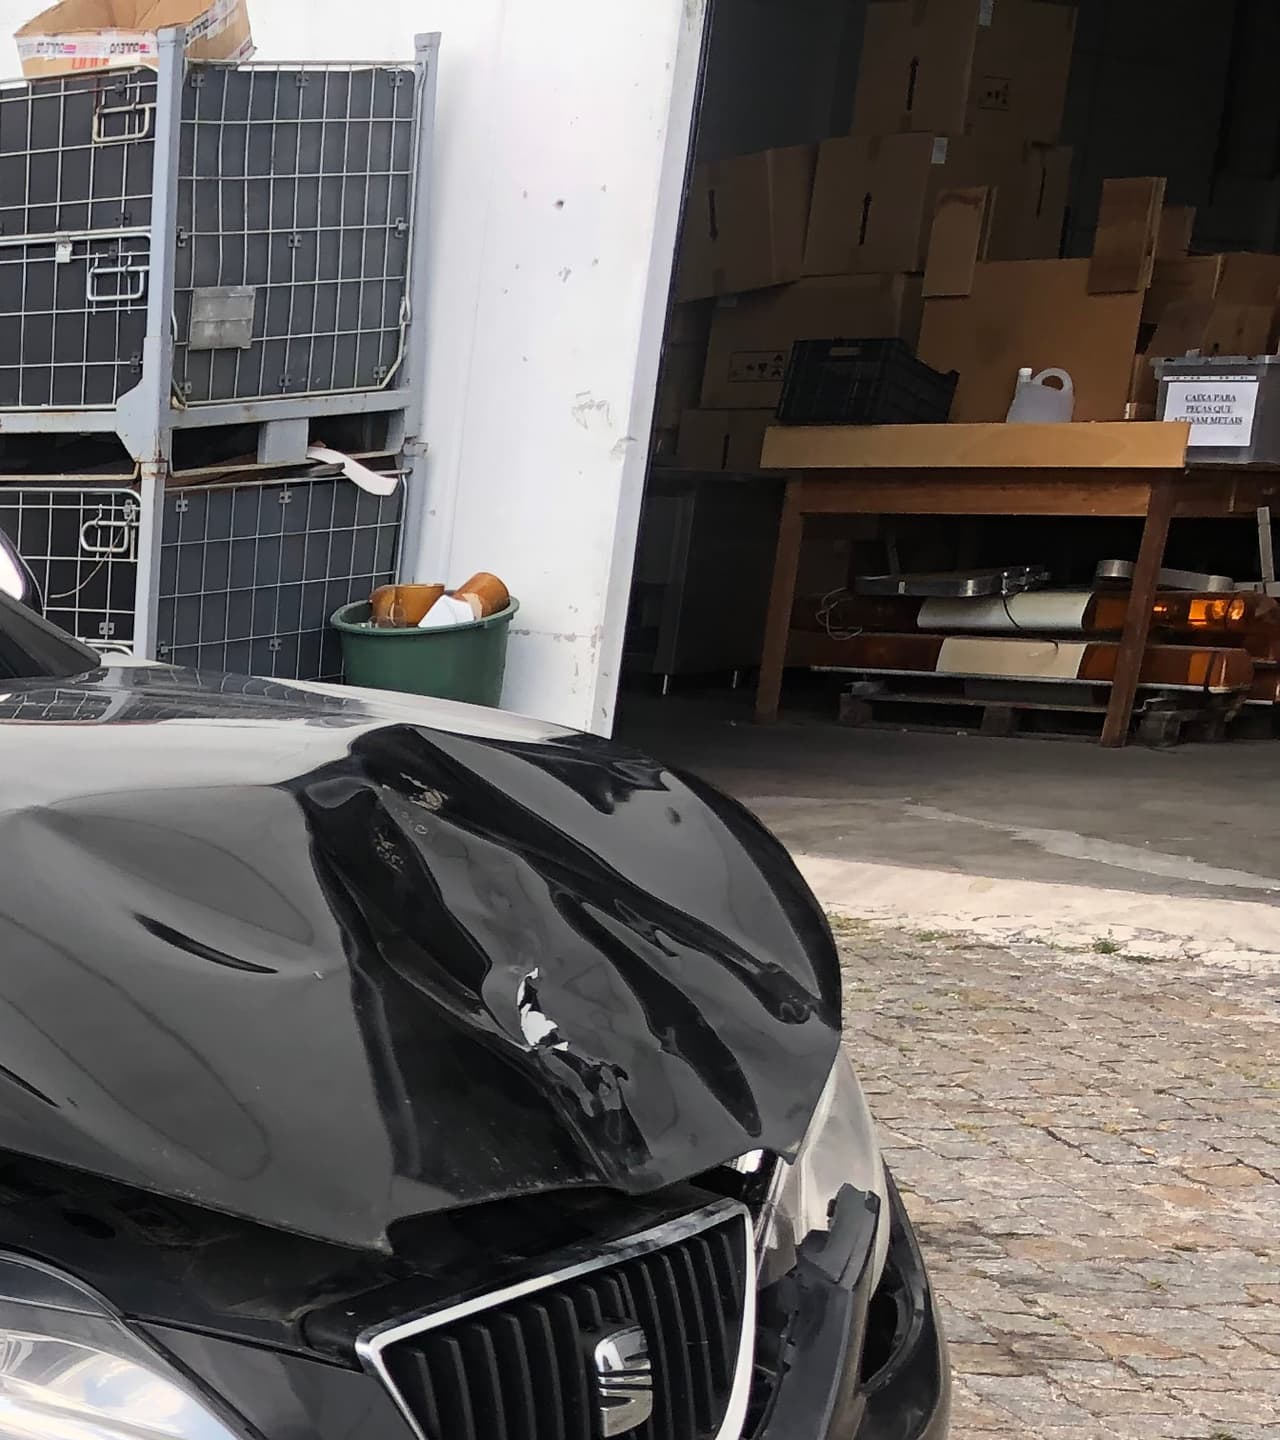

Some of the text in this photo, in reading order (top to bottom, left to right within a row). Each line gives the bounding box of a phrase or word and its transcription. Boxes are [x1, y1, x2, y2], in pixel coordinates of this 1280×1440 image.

[1185, 394, 1237, 402] CAIXA PARA
[1209, 416, 1243, 425] METAIS
